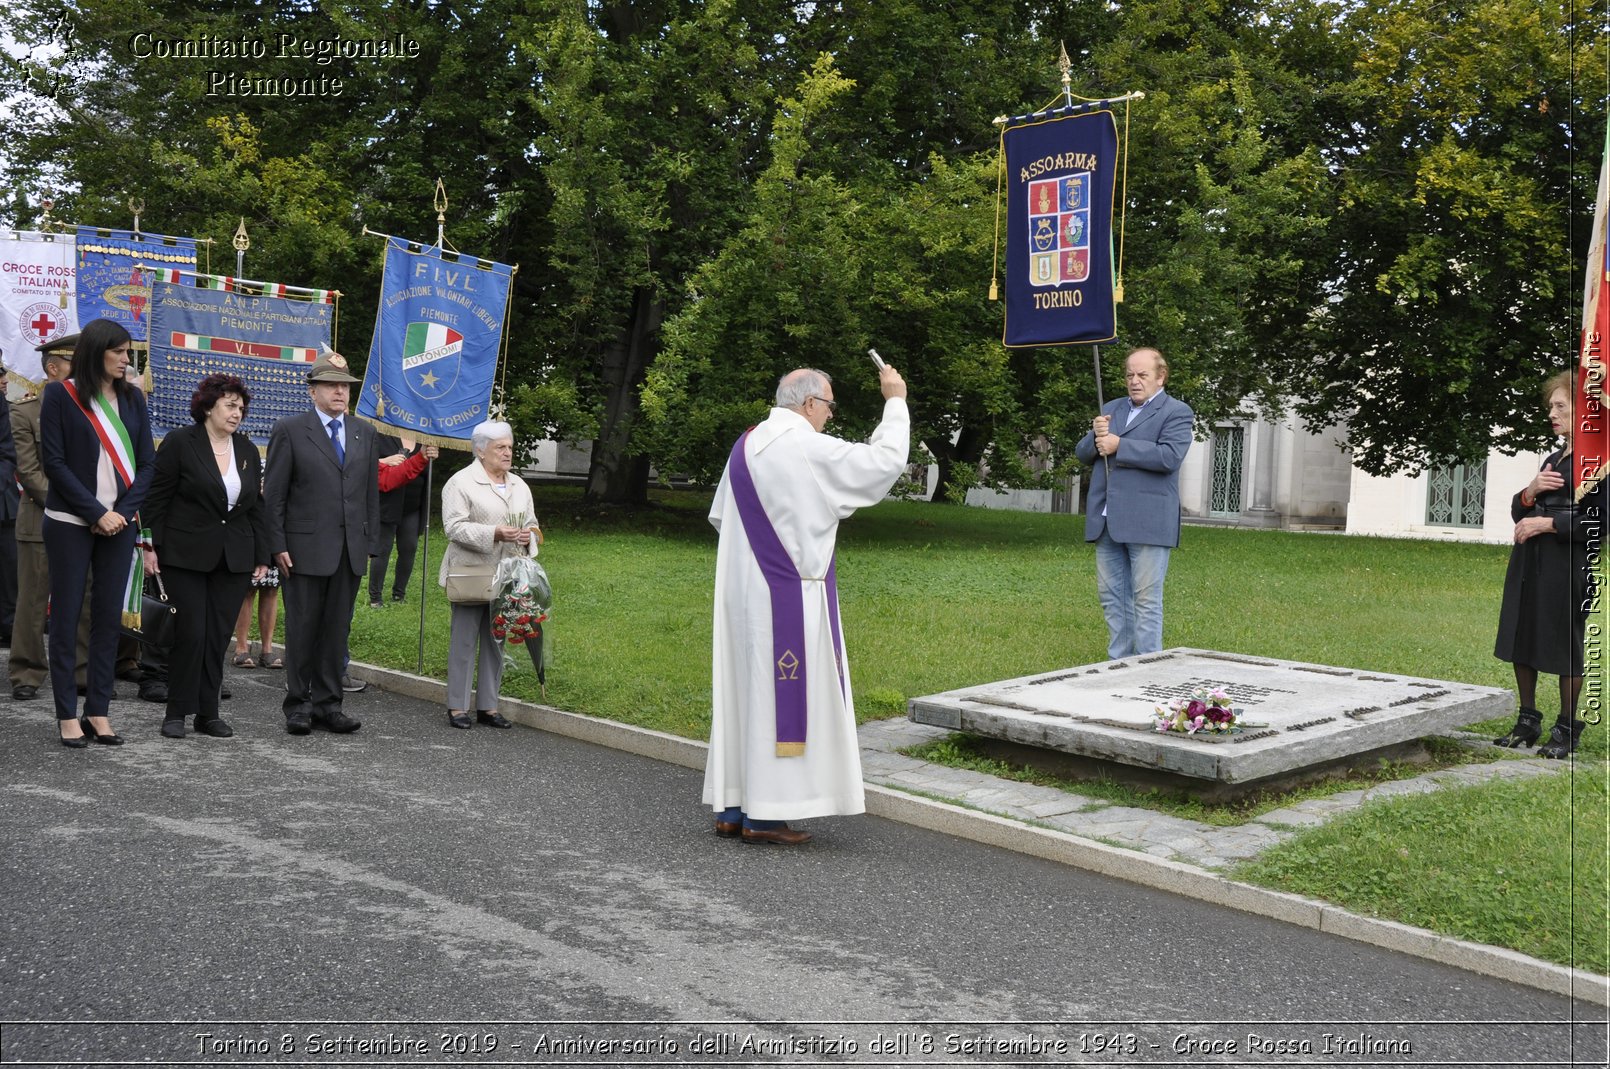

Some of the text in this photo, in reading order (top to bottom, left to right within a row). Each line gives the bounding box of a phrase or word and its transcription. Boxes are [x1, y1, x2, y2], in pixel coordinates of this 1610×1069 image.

[1020, 152, 1097, 183] ASSOARMA
[3, 262, 76, 277] CROCE ROSS
[19, 276, 69, 289] ITALIANA
[12, 288, 43, 296] COMITATO
[1033, 290, 1082, 309] TORINO
[101, 309, 130, 319] SEDE DI
[161, 297, 217, 313] ASSOCIAZIONE
[218, 306, 260, 320] NAZIONALE
[261, 312, 301, 324] PARTIGIANI
[420, 307, 459, 325] PIEMONTE
[221, 316, 273, 333] PIEMONTE
[404, 344, 457, 368] AUTONOMI
[420, 416, 432, 428] DI
[439, 404, 481, 428] TORINO
